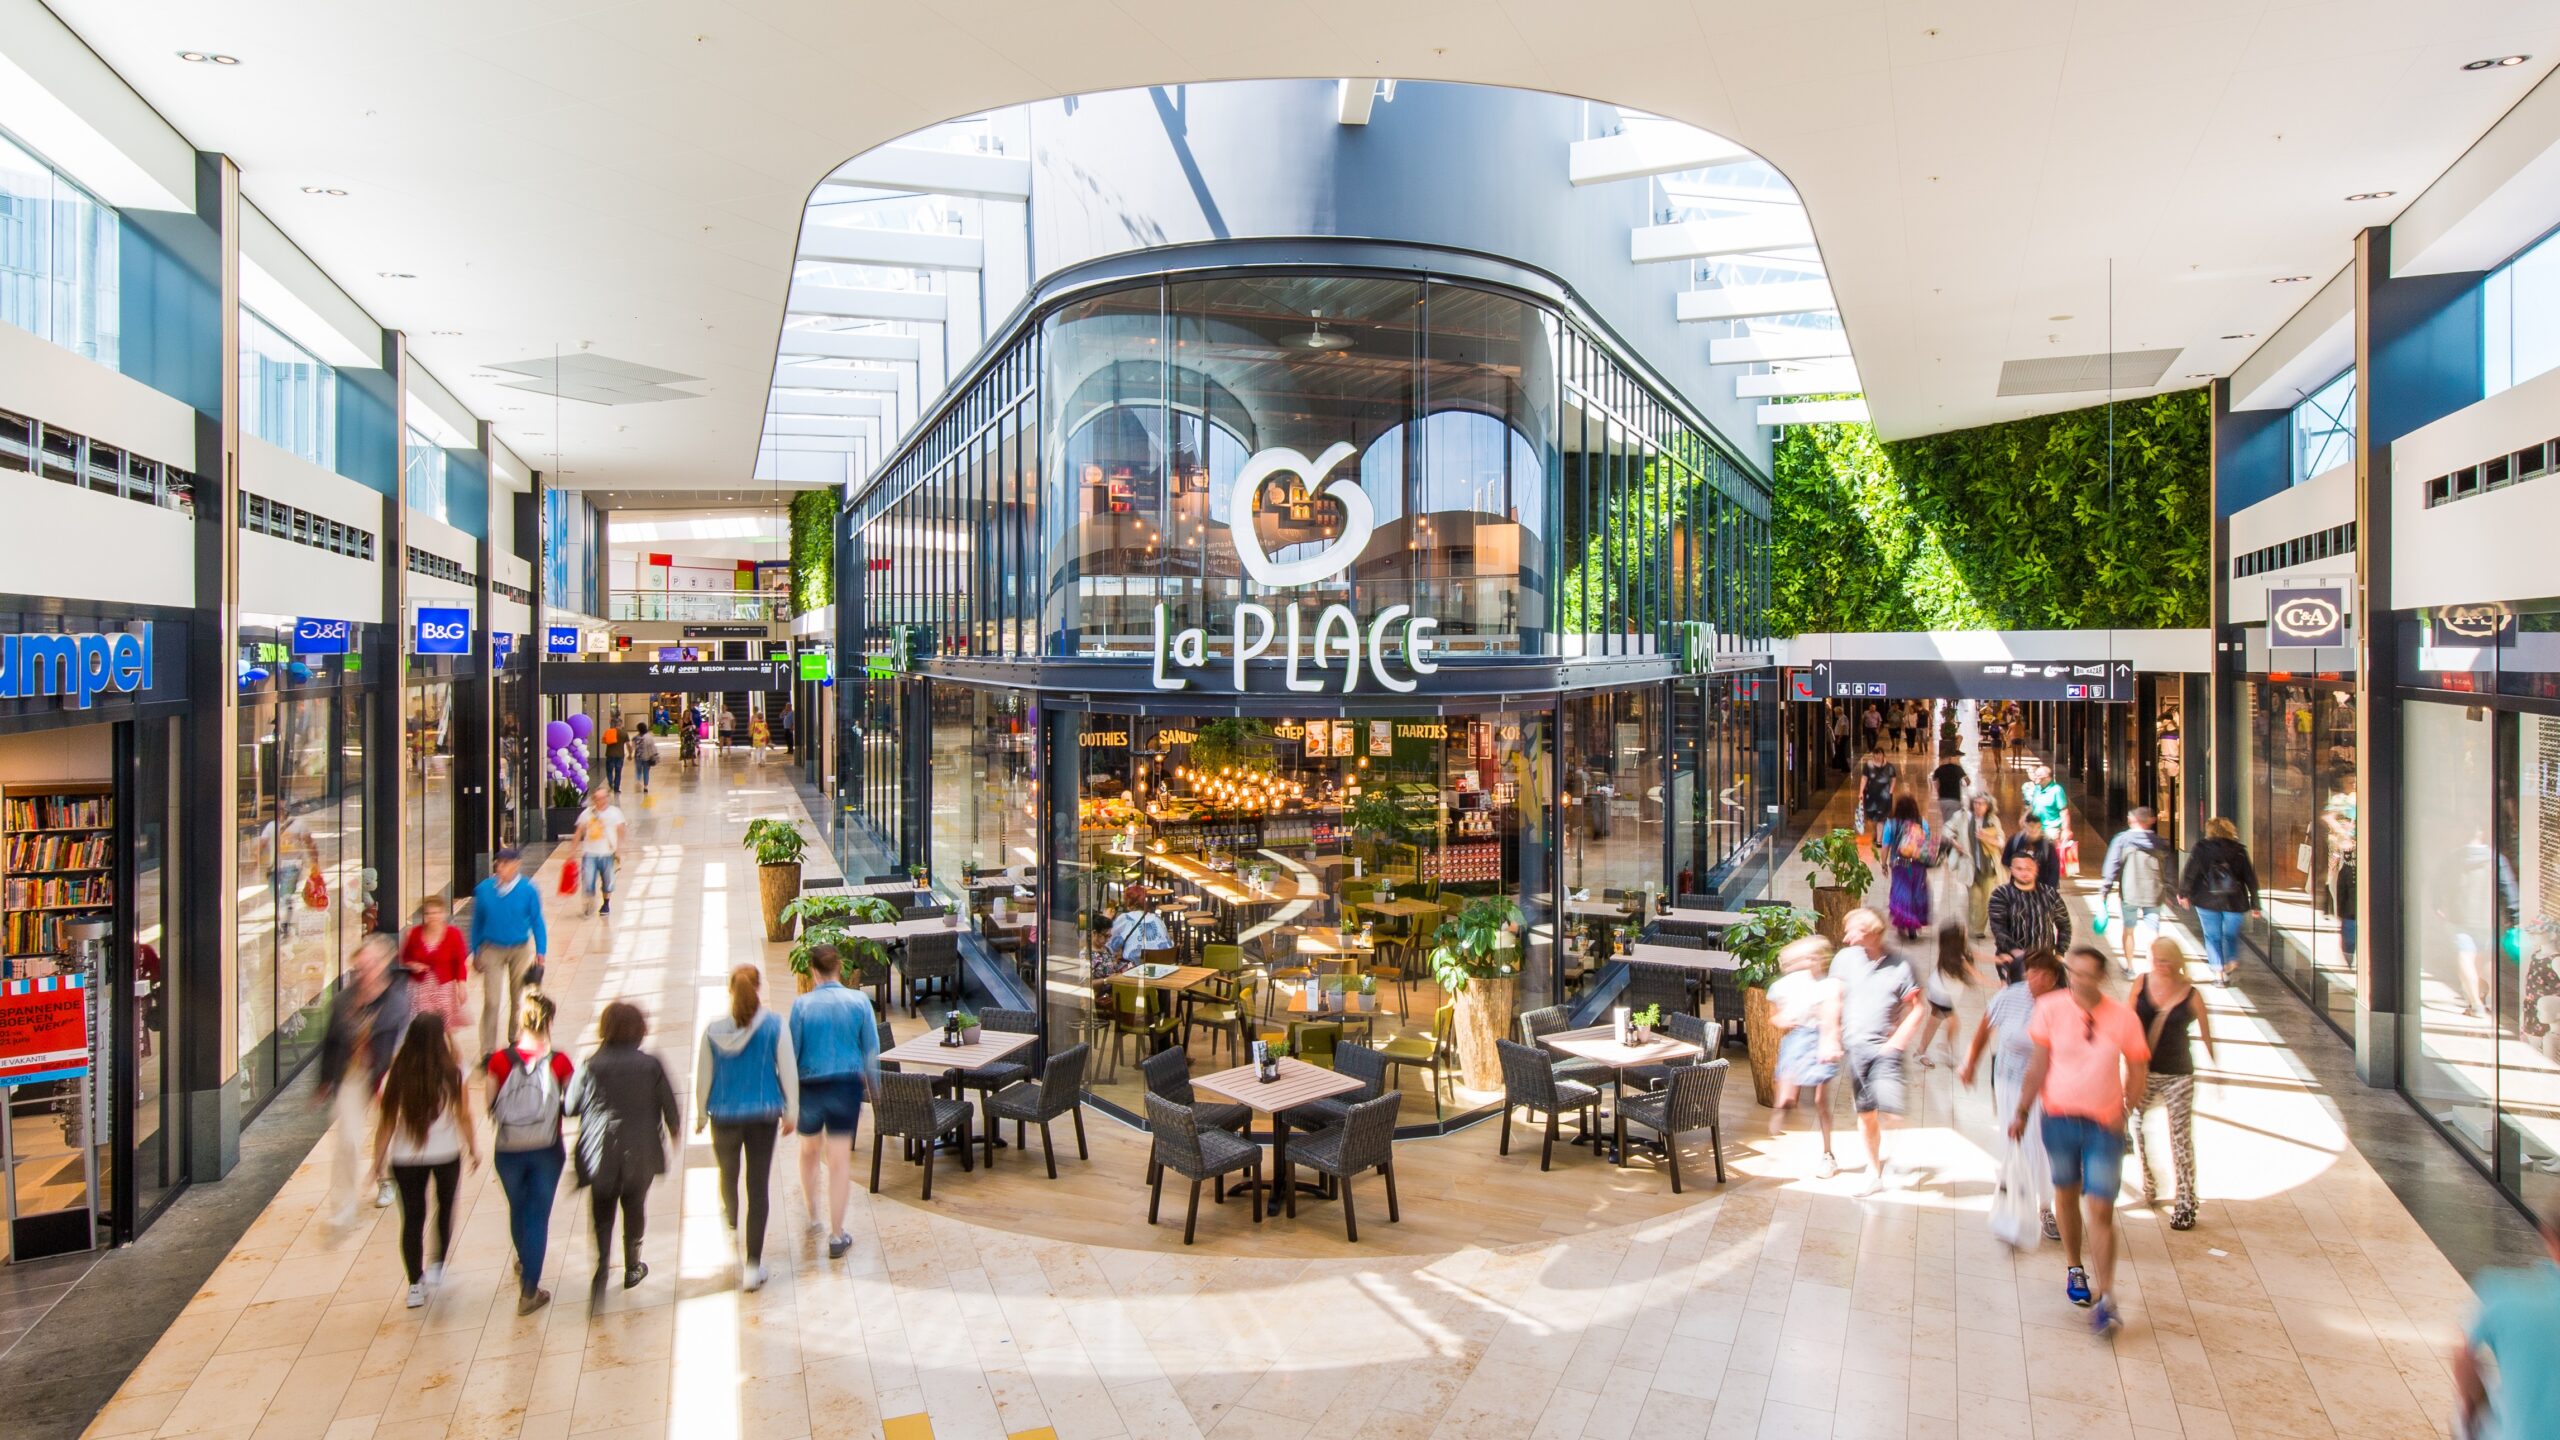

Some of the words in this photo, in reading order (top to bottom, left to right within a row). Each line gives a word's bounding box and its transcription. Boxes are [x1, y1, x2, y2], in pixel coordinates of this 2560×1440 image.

[2286, 607, 2329, 627] C&A
[422, 622, 465, 639] B&G
[1153, 602, 1208, 690] La
[1234, 602, 1438, 693] PLACE
[1869, 685, 1881, 693] P4
[1274, 726, 1305, 741] SOEP
[1396, 724, 1448, 740] TAARTJES
[9, 1054, 48, 1066] VAKANTIE
